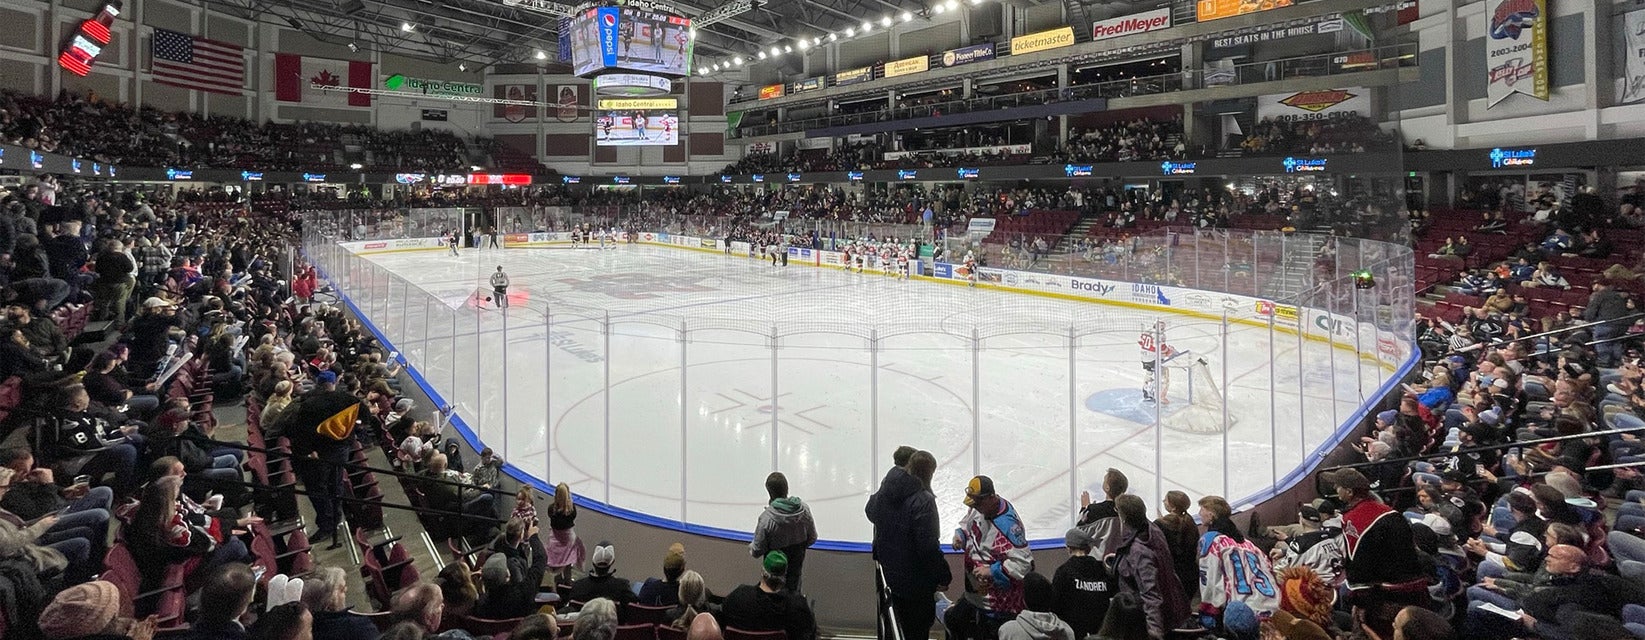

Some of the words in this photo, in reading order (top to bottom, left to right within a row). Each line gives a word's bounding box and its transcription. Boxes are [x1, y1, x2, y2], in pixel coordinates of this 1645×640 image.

[650, 2, 675, 12] Central
[604, 28, 615, 55] pepsi
[1015, 33, 1071, 51] ticketmaster
[1214, 38, 1233, 48] BEST
[1234, 34, 1259, 45] SEATS
[1260, 32, 1270, 40] IN
[1271, 28, 1287, 39] THE
[1287, 25, 1314, 36] HOUSE
[443, 82, 484, 94] Central
[1071, 280, 1109, 296] Brady
[1132, 284, 1156, 294] IDAHO
[75, 431, 88, 443] 8
[1230, 549, 1276, 598] 15
